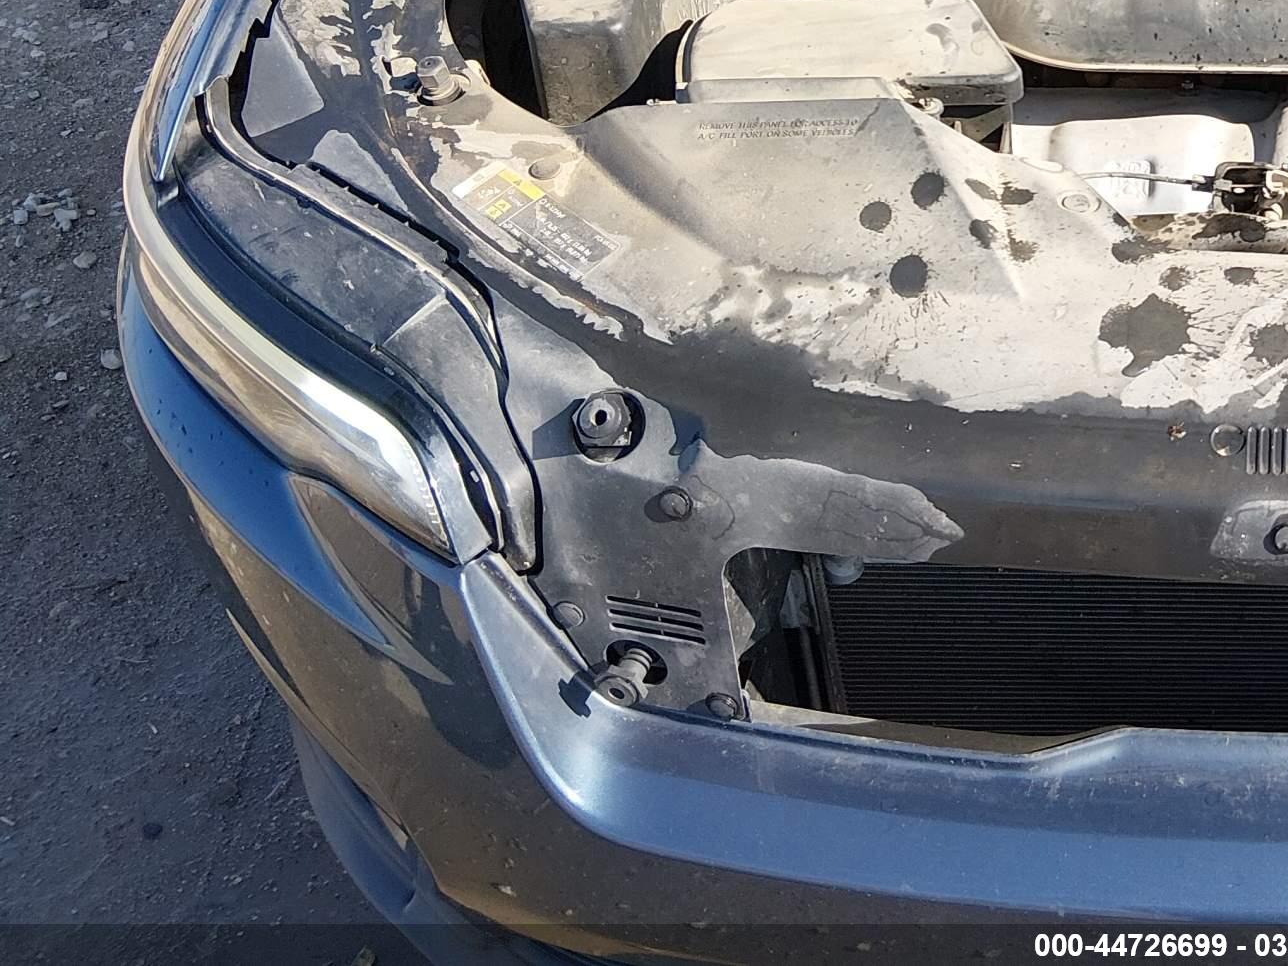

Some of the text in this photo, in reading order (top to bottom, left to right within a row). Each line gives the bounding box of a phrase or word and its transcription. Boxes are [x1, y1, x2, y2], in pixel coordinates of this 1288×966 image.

[699, 121, 735, 130] REMOVE
[738, 120, 757, 129] THIS
[758, 120, 788, 129] PANEL
[719, 131, 737, 139] FILL
[740, 130, 764, 139] PORT
[766, 130, 783, 138] ON
[783, 130, 809, 138] SOME
